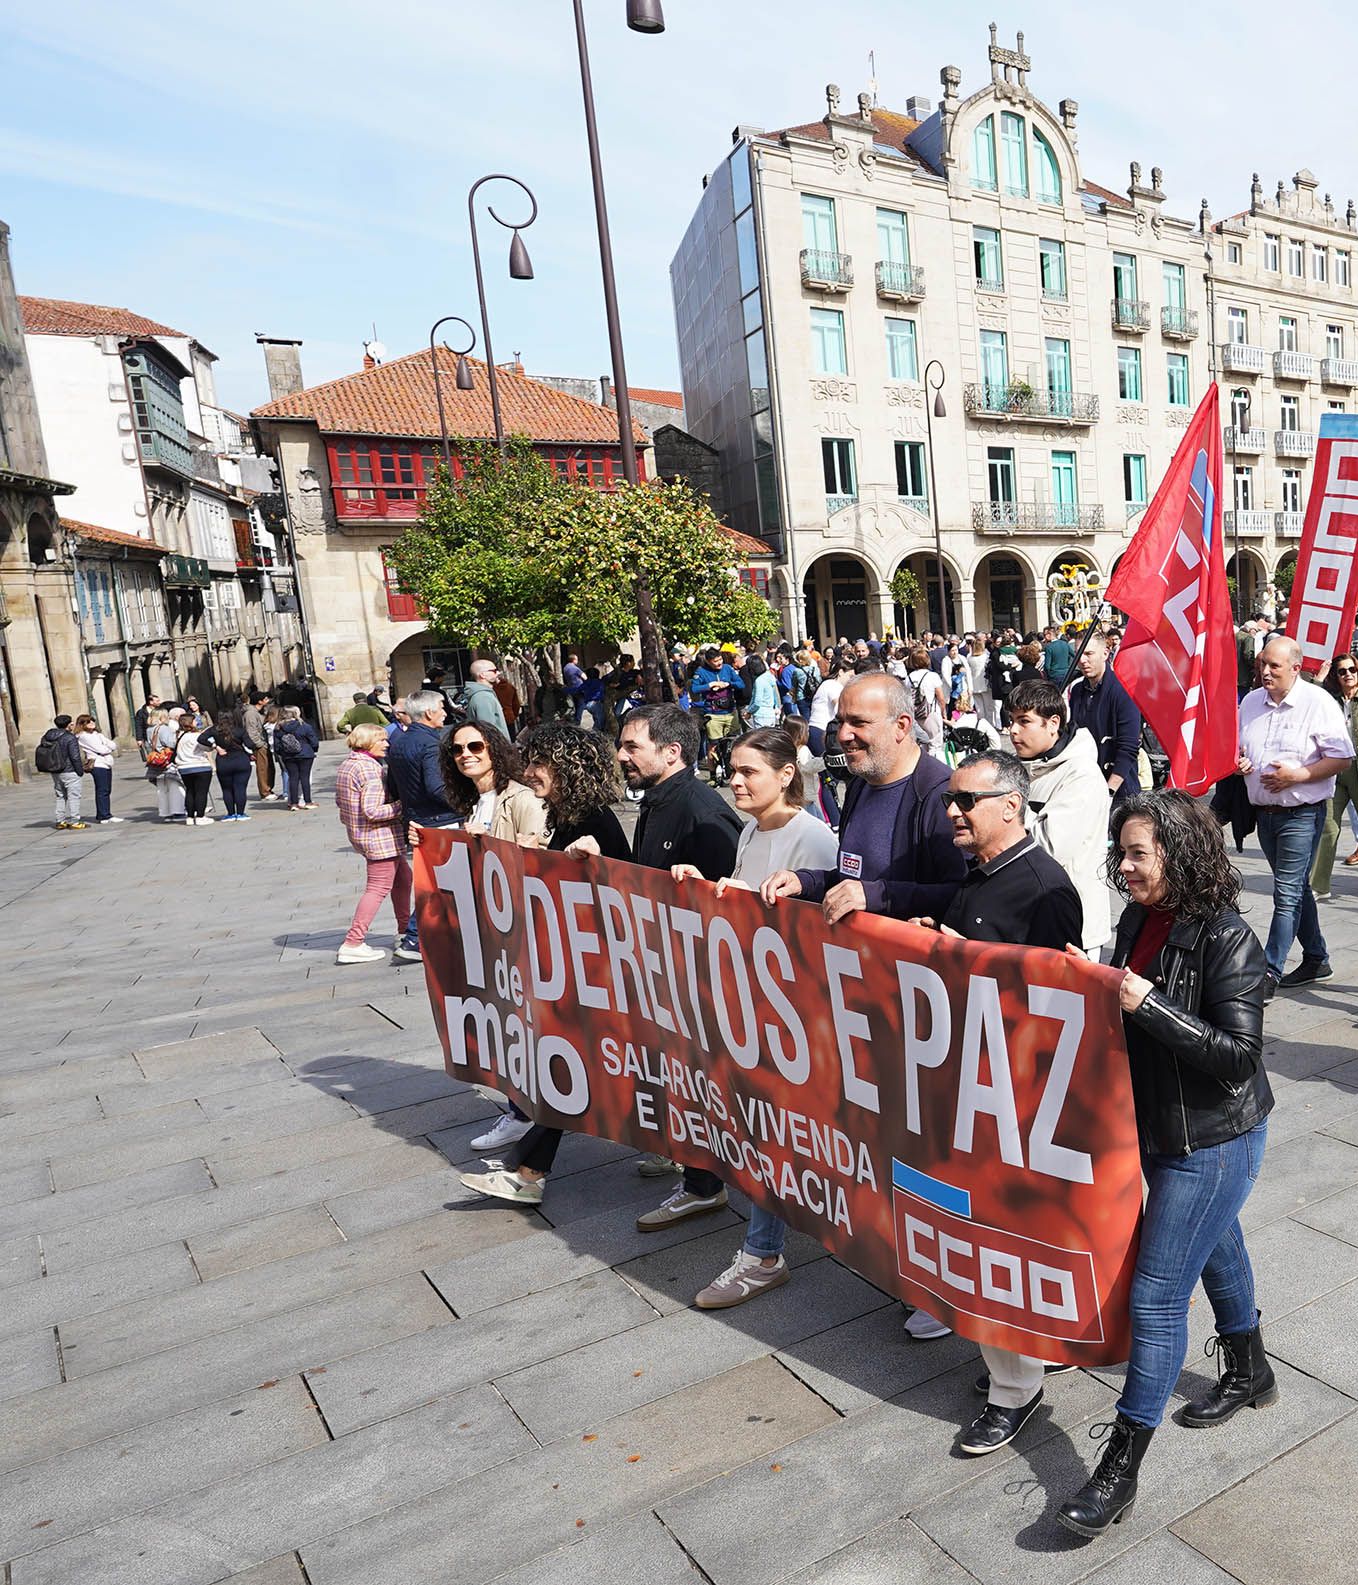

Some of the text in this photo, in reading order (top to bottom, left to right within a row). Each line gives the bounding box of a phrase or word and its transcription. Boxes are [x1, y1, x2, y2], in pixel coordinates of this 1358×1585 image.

[494, 949, 524, 1008] de
[523, 875, 1095, 1185] DEREITOS E PAZ
[444, 995, 590, 1116] maio
[600, 1036, 878, 1193] SALARIOS, VIVENDA
[635, 1090, 853, 1237] E DEMOCRACIA
[904, 1212, 1080, 1322] CCOO
